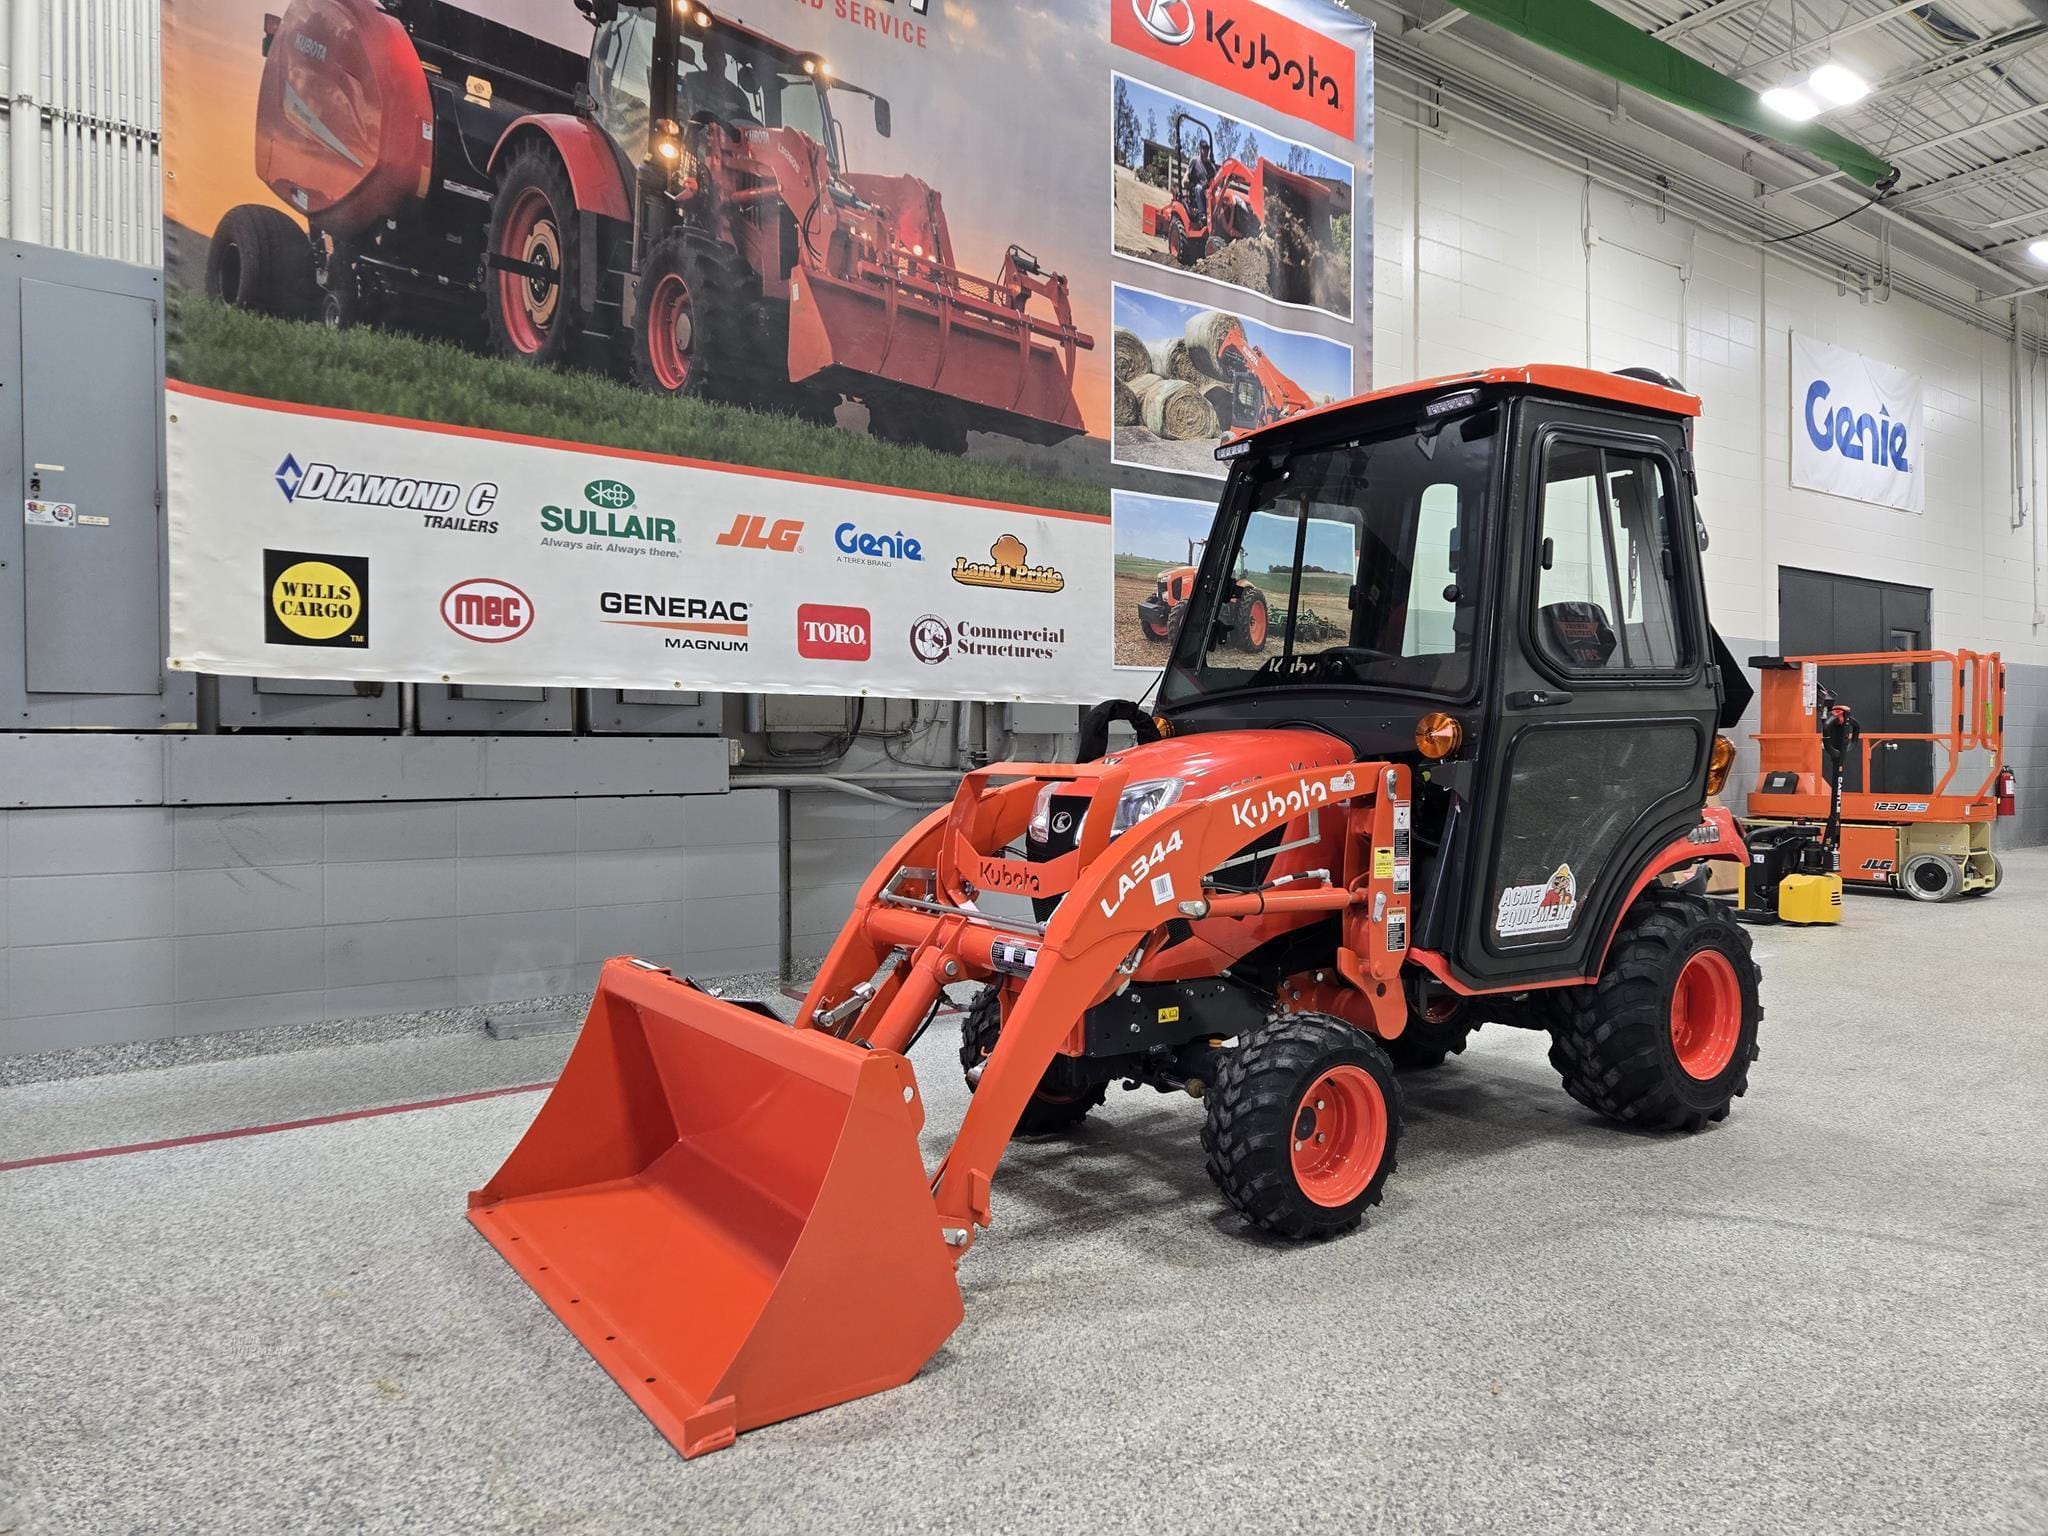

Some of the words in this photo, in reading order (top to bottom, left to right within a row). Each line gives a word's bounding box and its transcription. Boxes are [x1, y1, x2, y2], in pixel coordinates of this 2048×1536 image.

[835, 0, 927, 48] SERVICE
[1206, 9, 1339, 109] Kubota
[1805, 380, 1908, 472] Genie
[297, 463, 461, 512] DIAMOND
[465, 482, 499, 516] C
[424, 515, 499, 534] TRAILERS
[541, 505, 676, 543] SULLAIR
[716, 514, 805, 552] JLG
[541, 537, 583, 550] Always
[586, 541, 603, 551] air.
[606, 543, 646, 556] Always
[649, 548, 680, 559] there.
[835, 522, 922, 561] Genie
[844, 557, 866, 566] TEREX
[867, 559, 892, 568] BRAND
[955, 556, 1001, 581] Land
[1013, 563, 1063, 586] Pride
[281, 581, 351, 601] WELLS
[280, 600, 353, 619] CARGO
[600, 592, 748, 622] GENERAC
[665, 638, 748, 652] MAGNUM
[957, 620, 1065, 643] Commercial
[957, 638, 1054, 660] Structures
[1231, 779, 1327, 828] Kubota
[1874, 802, 1928, 811] 1230ES
[980, 862, 1040, 892] Kubota
[1100, 829, 1183, 918] LA344
[1861, 859, 1893, 870] JLG
[1500, 888, 1541, 907] ACME
[1498, 903, 1575, 927] EQUIPMENT
